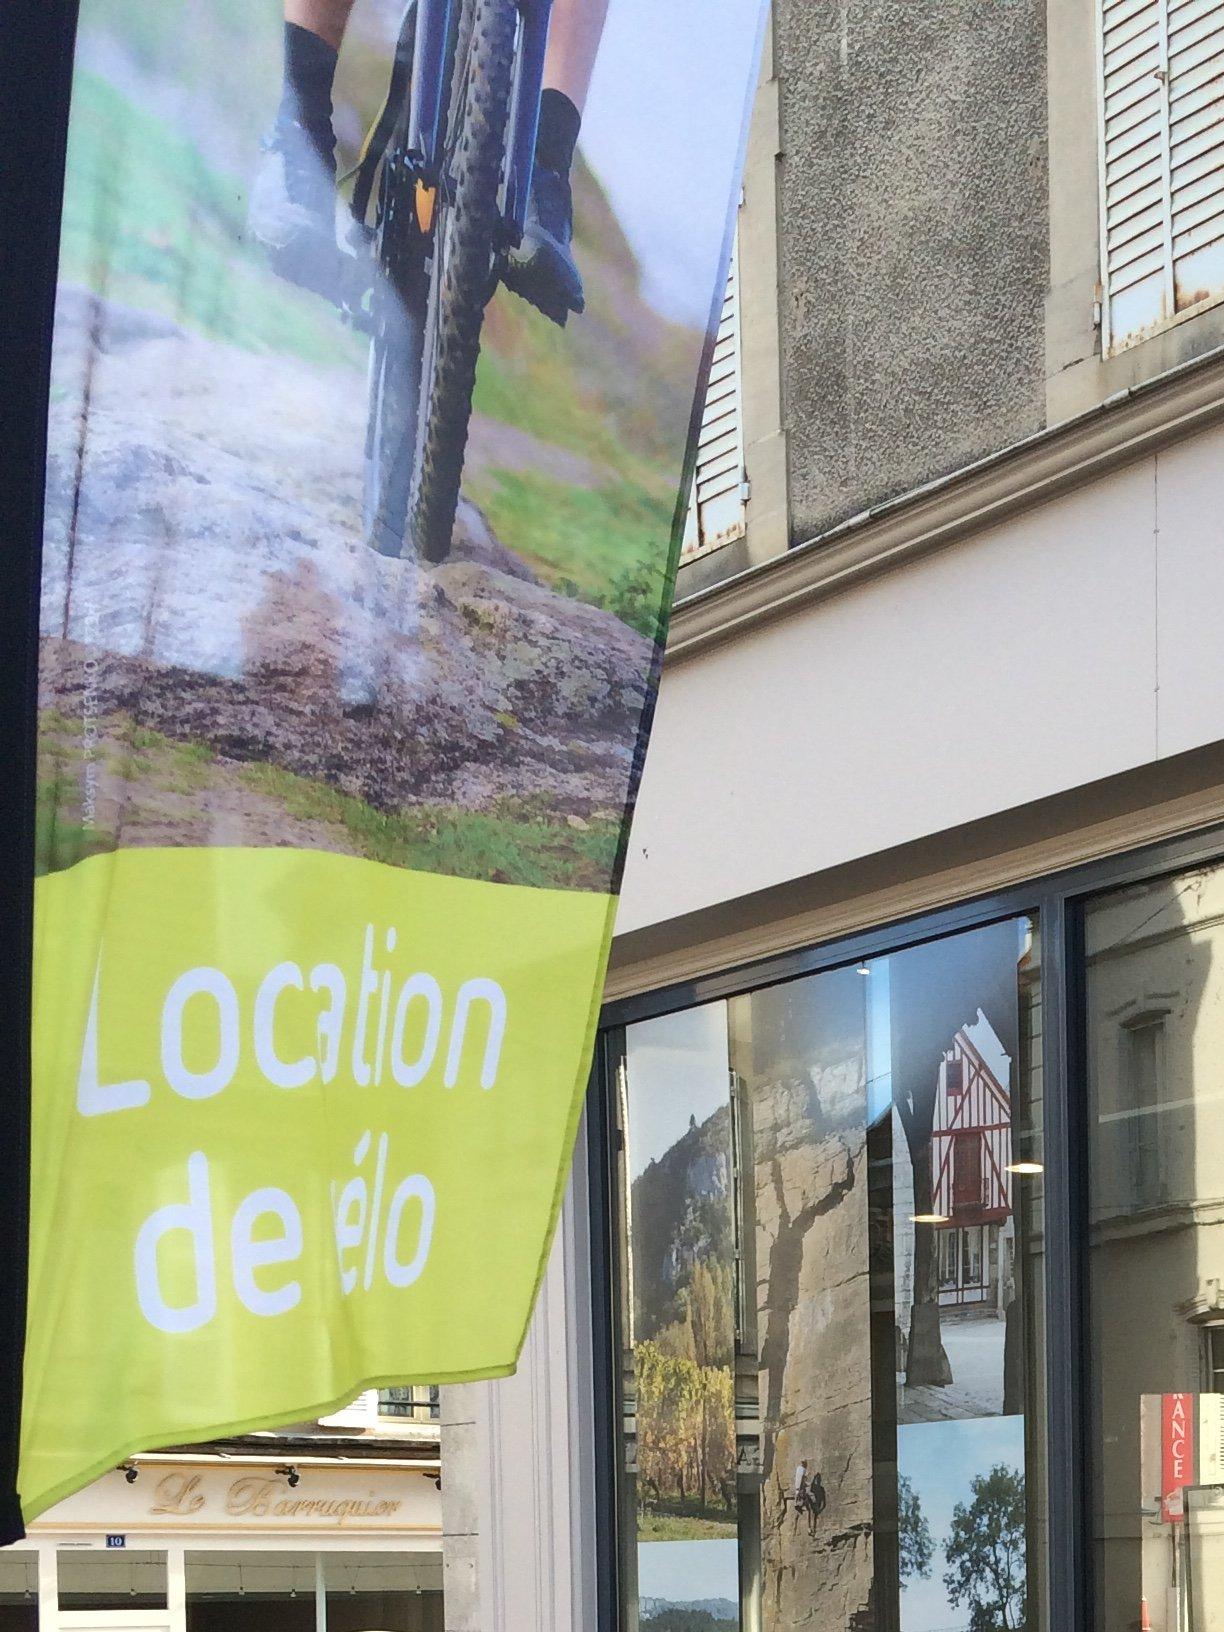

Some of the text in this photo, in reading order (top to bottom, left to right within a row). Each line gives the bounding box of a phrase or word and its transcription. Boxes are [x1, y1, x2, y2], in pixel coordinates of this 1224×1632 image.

[76, 922, 508, 1117] Location
[133, 1129, 437, 1334] de élo
[110, 1536, 123, 1547] 10
[150, 1471, 404, 1526] Le Barruquier
